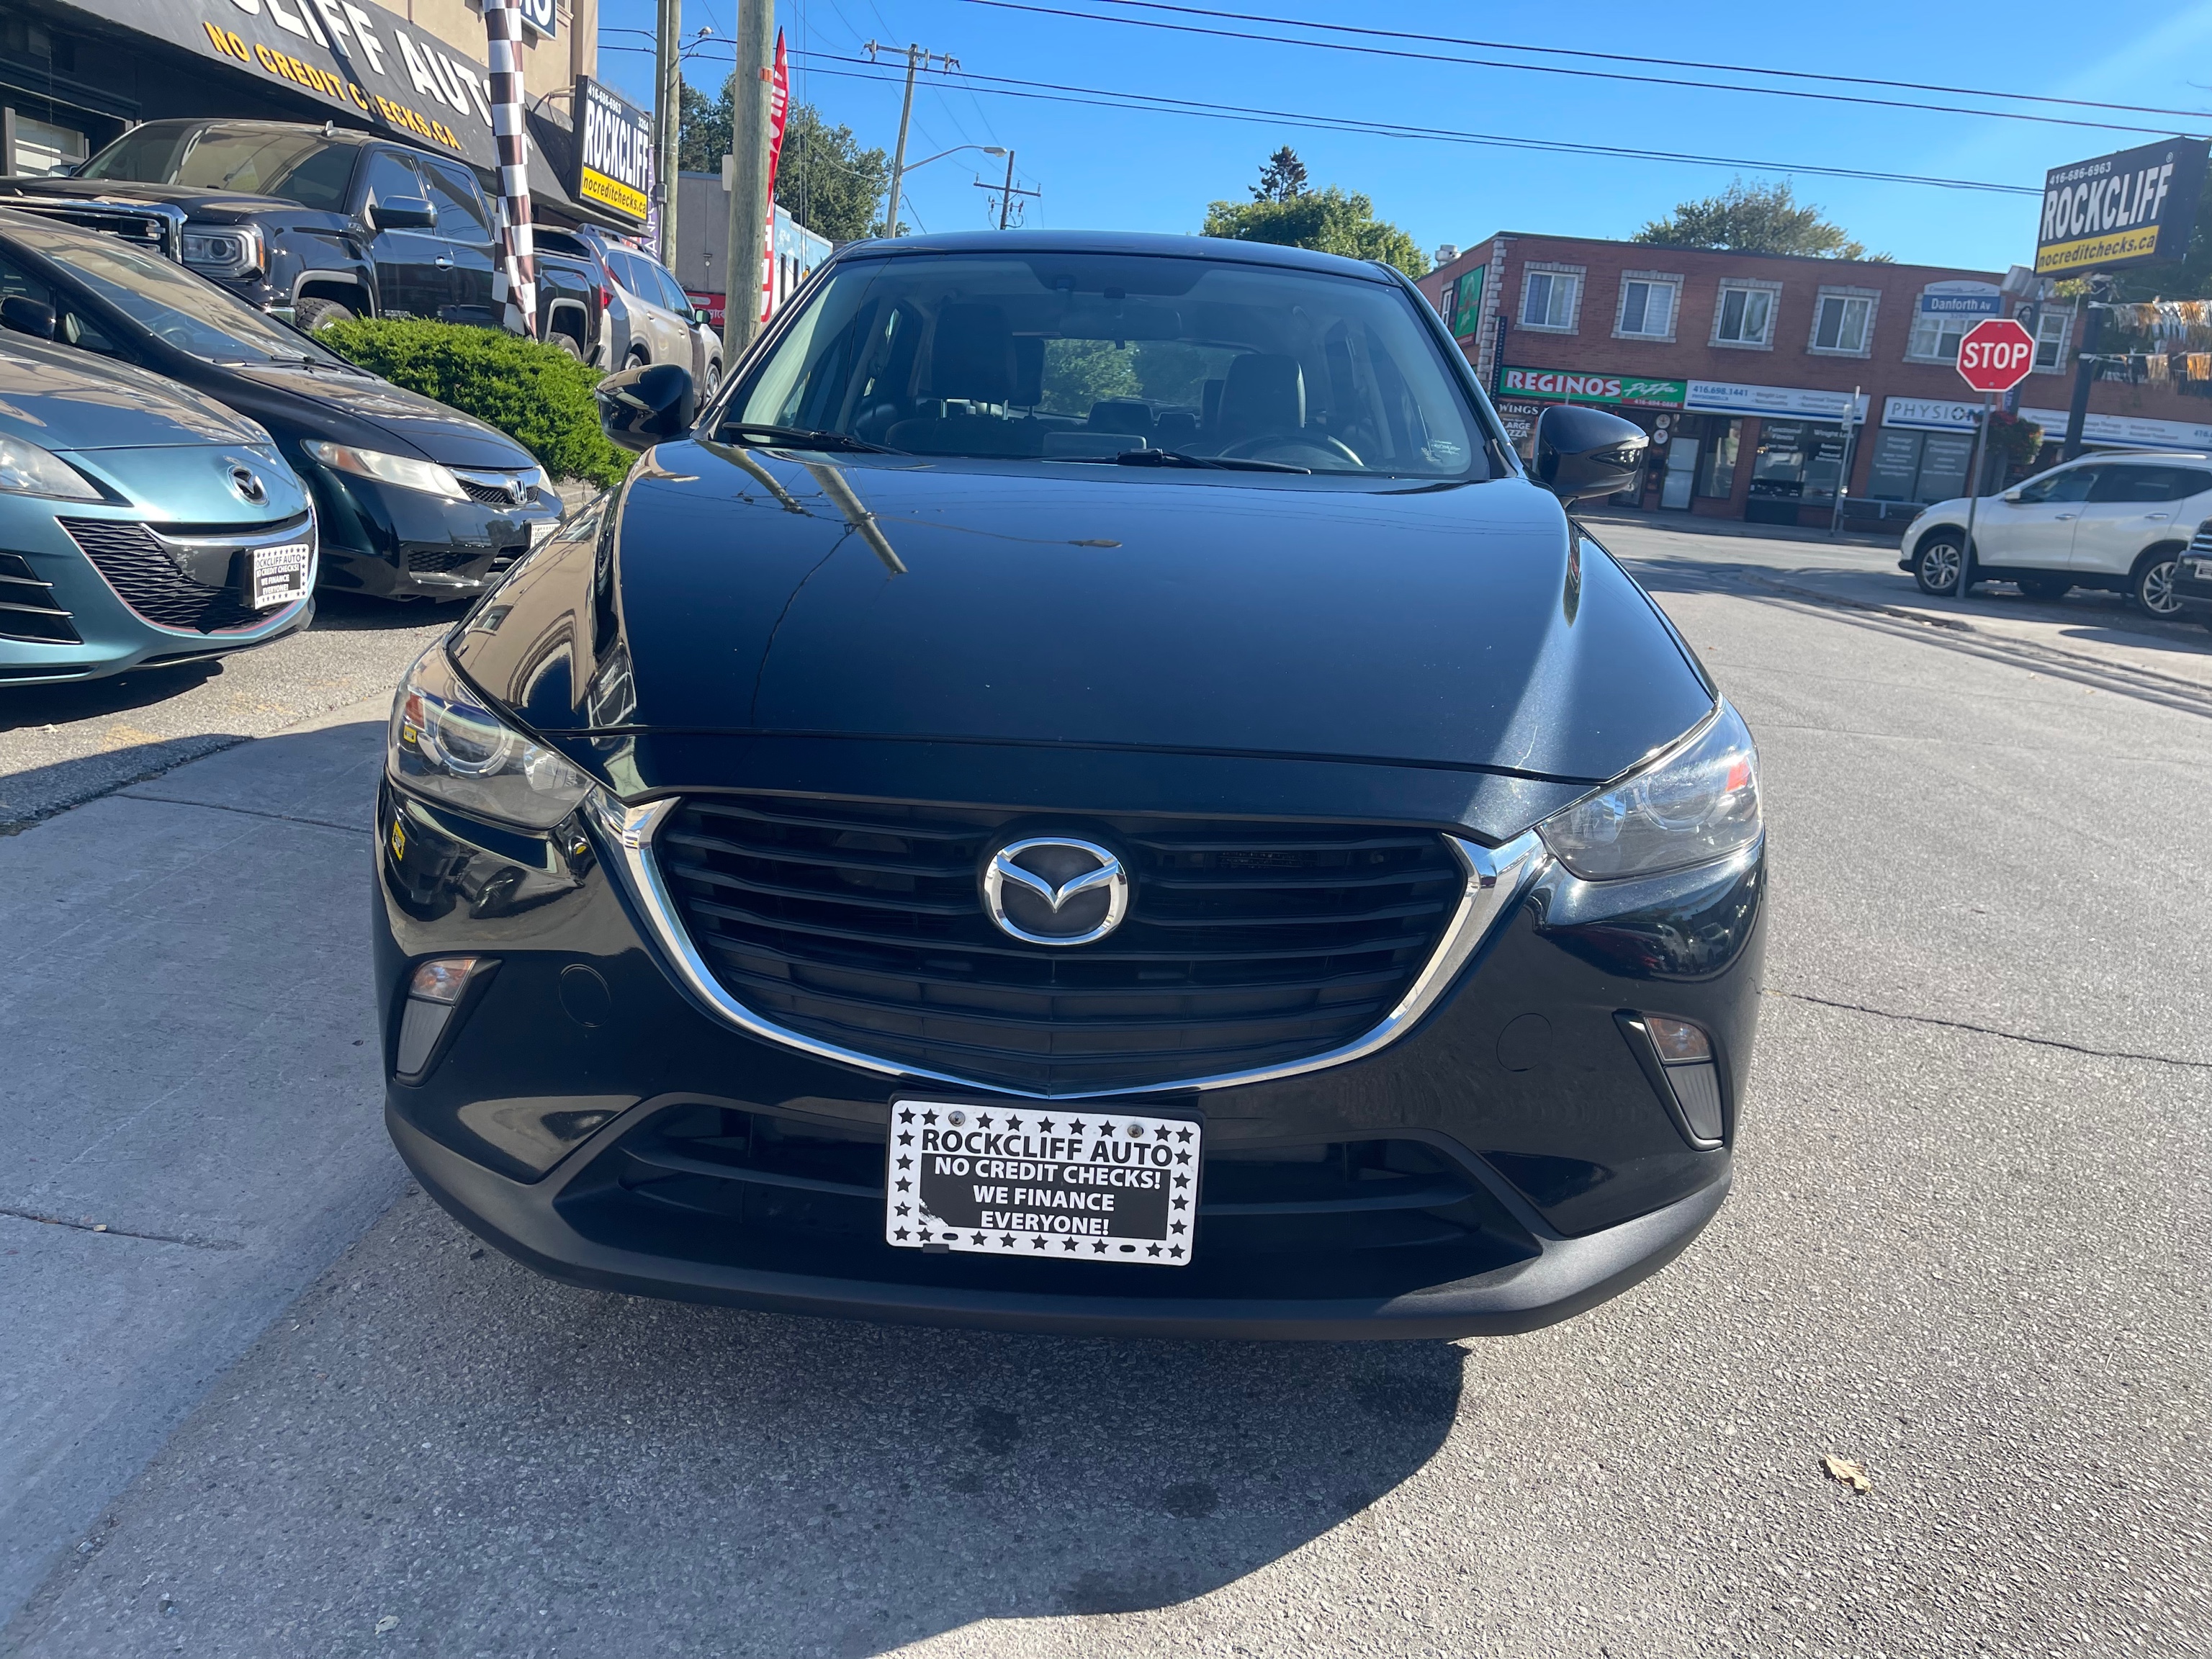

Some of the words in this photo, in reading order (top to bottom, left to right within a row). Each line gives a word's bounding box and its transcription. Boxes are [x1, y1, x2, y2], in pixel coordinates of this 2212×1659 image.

[203, 22, 251, 63] NO
[254, 43, 346, 102] CREDIT
[348, 83, 462, 151] CHECKS.CA
[395, 28, 493, 128] AUT
[588, 84, 621, 114] 416-686-6963
[584, 99, 649, 192] ROCKCLIFF
[2049, 161, 2112, 186] 416-686-6963
[583, 176, 646, 215] nocreditchecks.ca
[2041, 162, 2174, 242] ROCKCLIFF
[2037, 235, 2156, 268] nocreditchecks.ca
[1931, 297, 1978, 311] Danforth
[1980, 301, 1992, 310] Av
[1962, 341, 2029, 370] STOP
[1505, 370, 1622, 397] REGINOS
[1693, 385, 1748, 397] 416.698.1441
[1498, 402, 1539, 415] WINGS
[1506, 429, 1528, 438] ZZA
[255, 556, 282, 568] OCKCLIFF
[283, 554, 301, 563] AUTO
[922, 1128, 1083, 1161] ROCKCLIFF
[1090, 1139, 1173, 1167] AUTO
[935, 1156, 973, 1177] NO
[975, 1159, 1058, 1183] CREDIT
[1063, 1164, 1161, 1190] CHECKS!
[973, 1184, 1009, 1205] WE
[1014, 1187, 1115, 1213] FINANCE
[981, 1210, 1110, 1236] EVERYONE!
